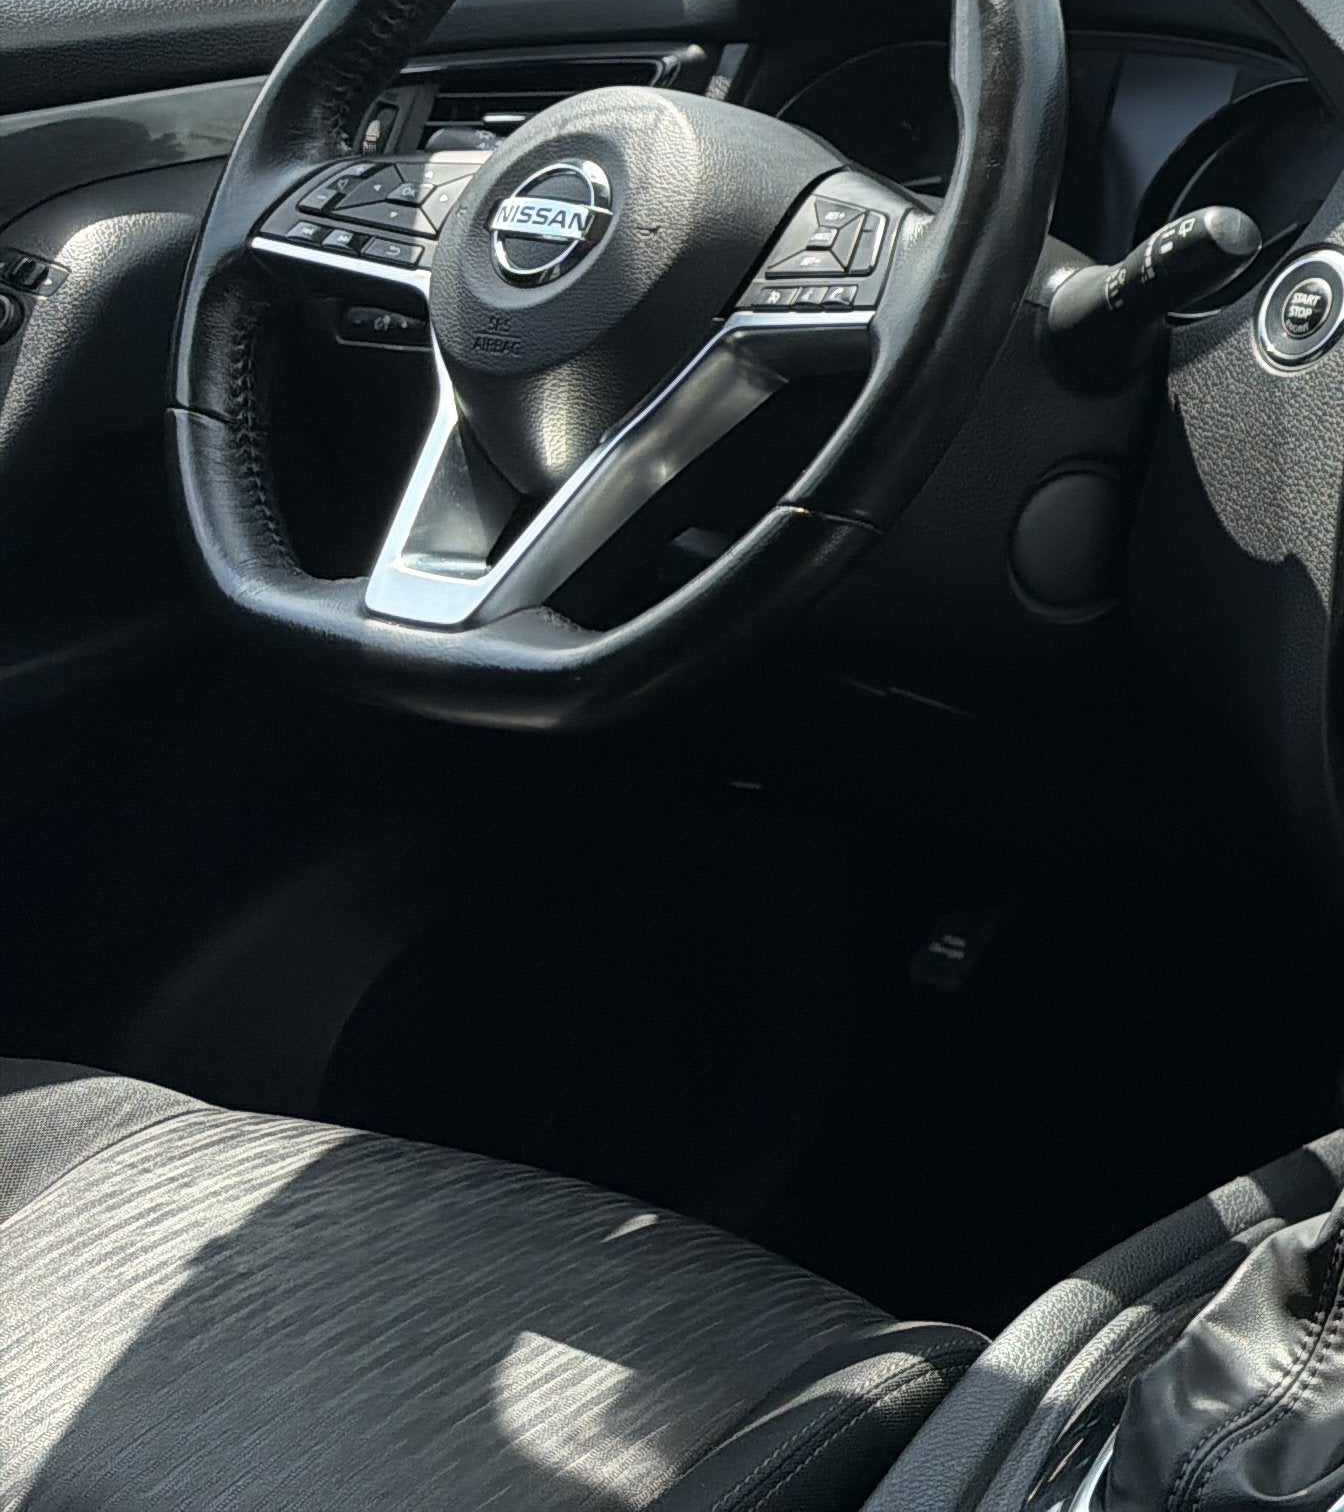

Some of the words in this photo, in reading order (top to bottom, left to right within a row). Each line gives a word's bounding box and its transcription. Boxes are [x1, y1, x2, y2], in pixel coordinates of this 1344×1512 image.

[498, 204, 590, 232] NISSAN
[1290, 292, 1321, 307] START
[1287, 305, 1313, 319] STOP
